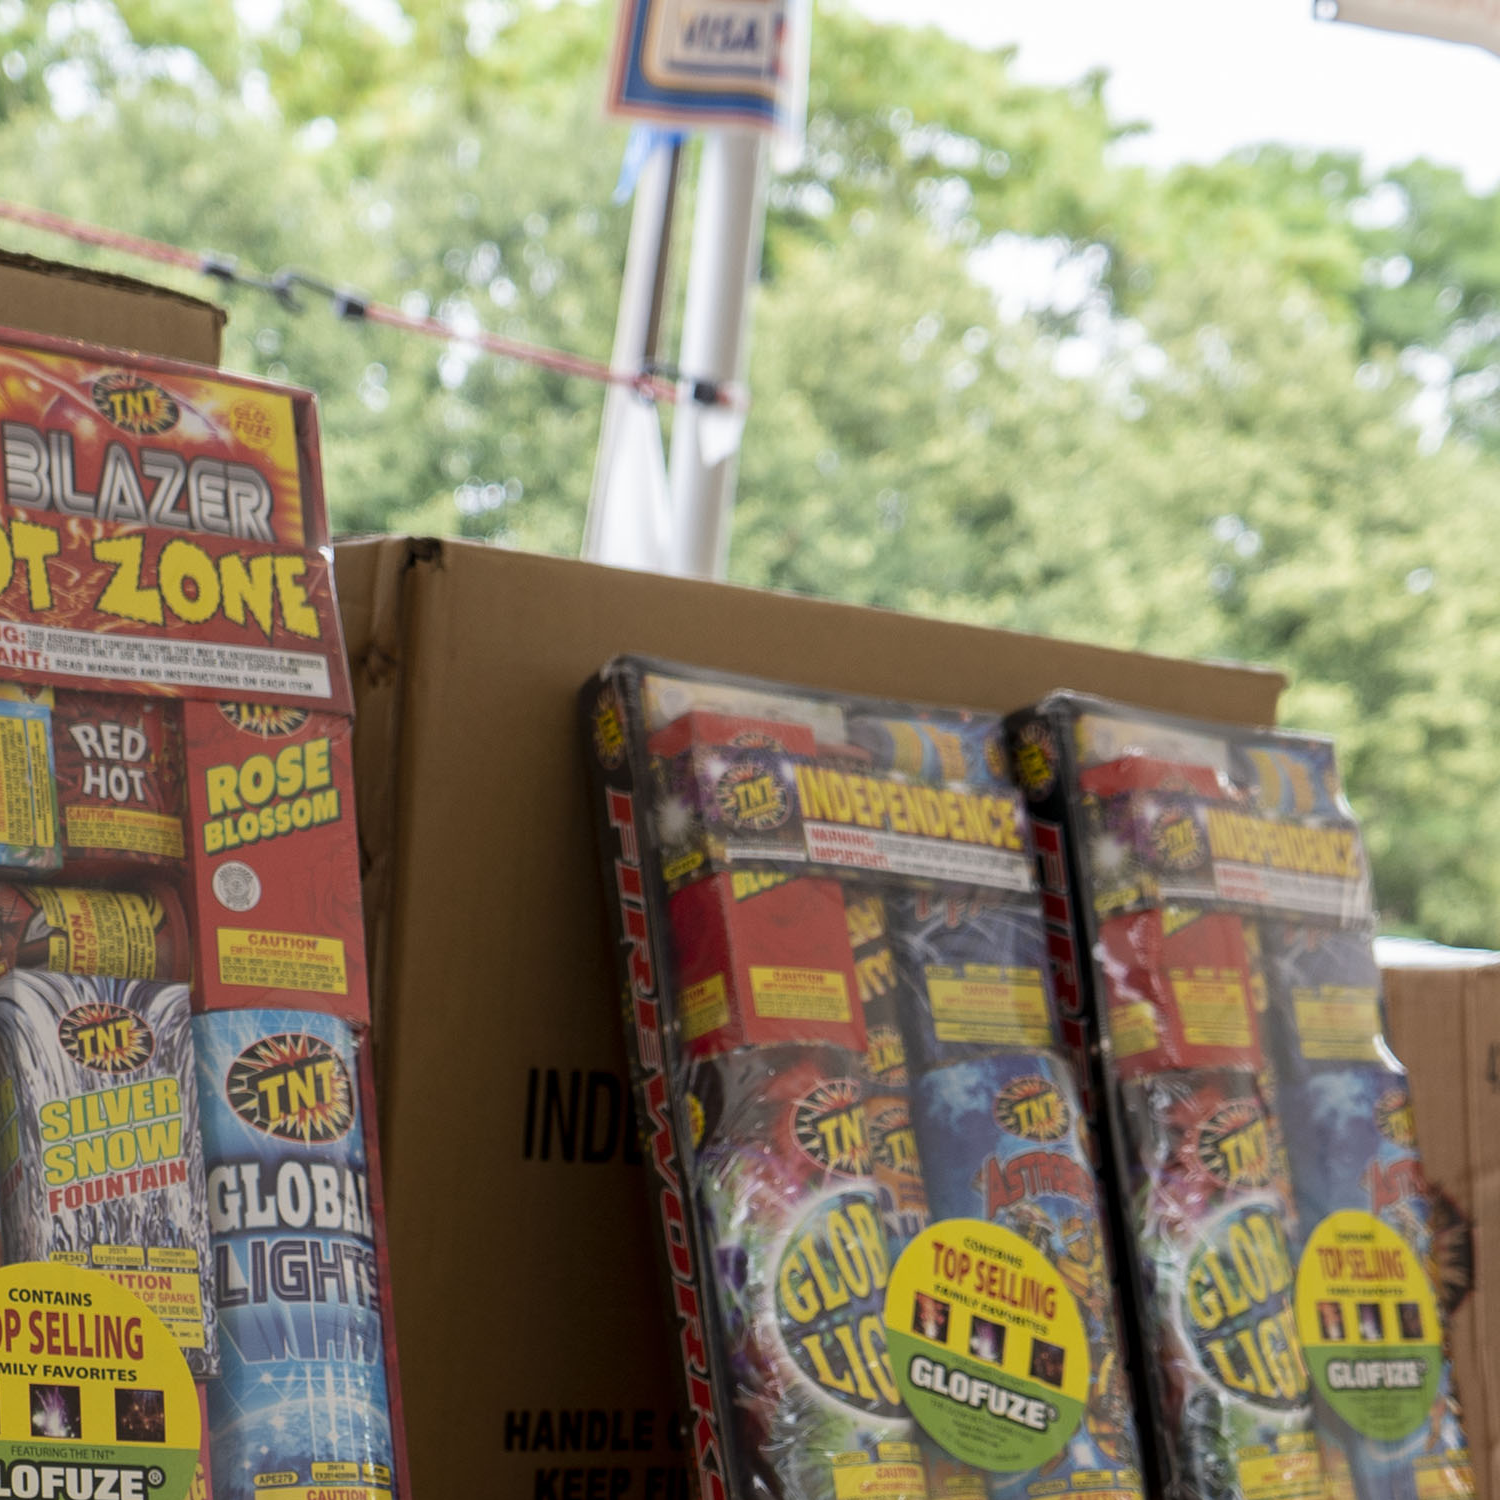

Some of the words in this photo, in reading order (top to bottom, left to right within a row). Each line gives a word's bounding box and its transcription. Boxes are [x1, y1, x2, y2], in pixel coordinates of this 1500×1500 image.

[108, 391, 159, 421] TNT
[2, 421, 278, 542] BLAZER
[95, 535, 323, 641] ZONE
[69, 724, 149, 762] RED
[82, 762, 145, 803] HOT
[206, 737, 332, 816] ROSE
[734, 776, 775, 809] TNT
[202, 789, 341, 855] BLOSSOM
[794, 764, 1026, 851] INDEPENDENCE
[77, 1019, 133, 1055] TNT
[39, 1075, 183, 1143] SILVER
[258, 1060, 333, 1117] TNT
[1014, 1093, 1059, 1127] TNT
[42, 1118, 183, 1187] SNOW
[48, 1159, 188, 1215] FOUNTAIN
[8, 1287, 93, 1307] CONTAINS
[931, 1240, 972, 1286] TOP
[974, 1260, 1057, 1321] SELLING
[27, 1310, 145, 1361] SELLING
[43, 1364, 138, 1382] FAVORITES
[503, 1408, 656, 1453] HANDLE
